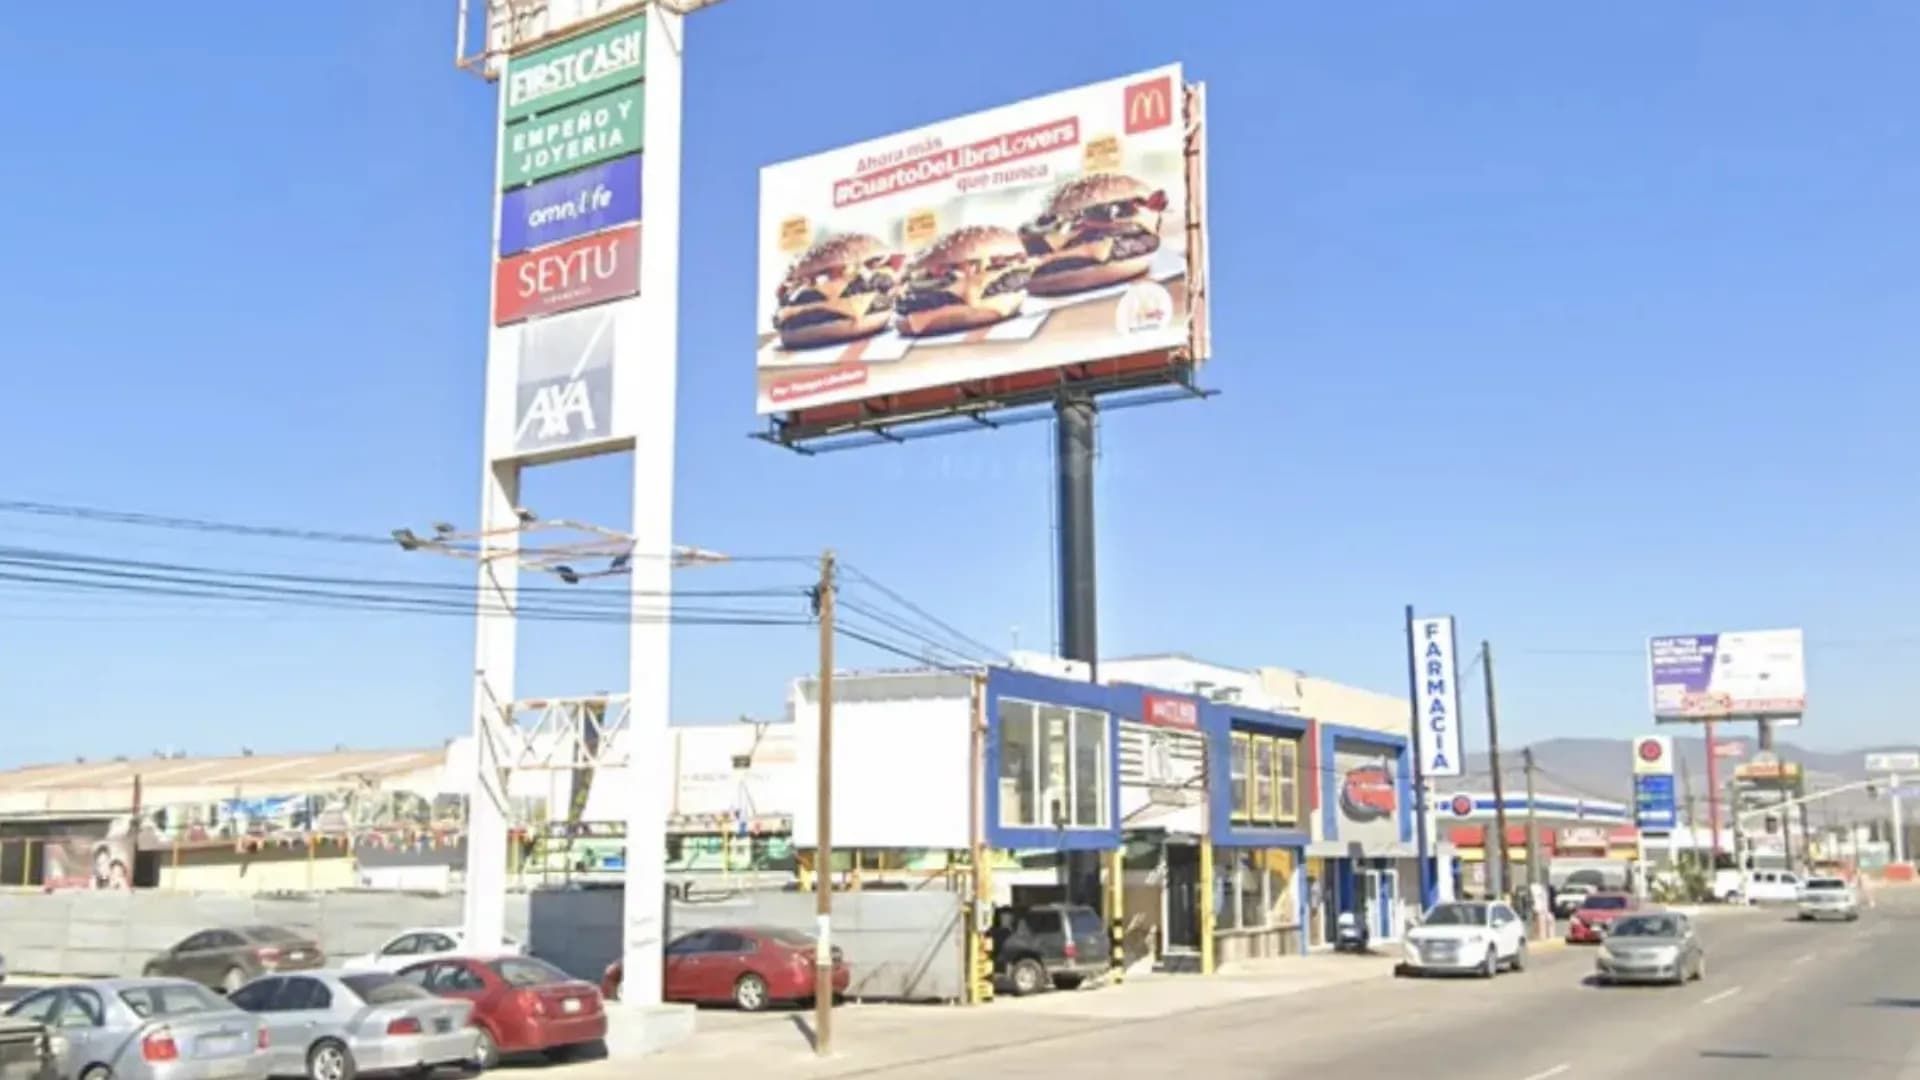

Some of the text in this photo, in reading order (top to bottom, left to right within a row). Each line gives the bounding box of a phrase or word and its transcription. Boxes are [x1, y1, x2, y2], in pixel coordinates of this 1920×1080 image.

[510, 31, 642, 107] FIRSTCASH
[513, 99, 633, 152] EMPEÑO Y
[520, 128, 624, 172] JOYERIA
[836, 123, 1075, 202] #CuartoDeLibraLovers
[856, 148, 903, 173] Ahora
[957, 163, 1049, 192] que nunca
[528, 184, 613, 228] omnlfe
[515, 379, 596, 442] AXA
[1425, 623, 1449, 770] FARMACIA
